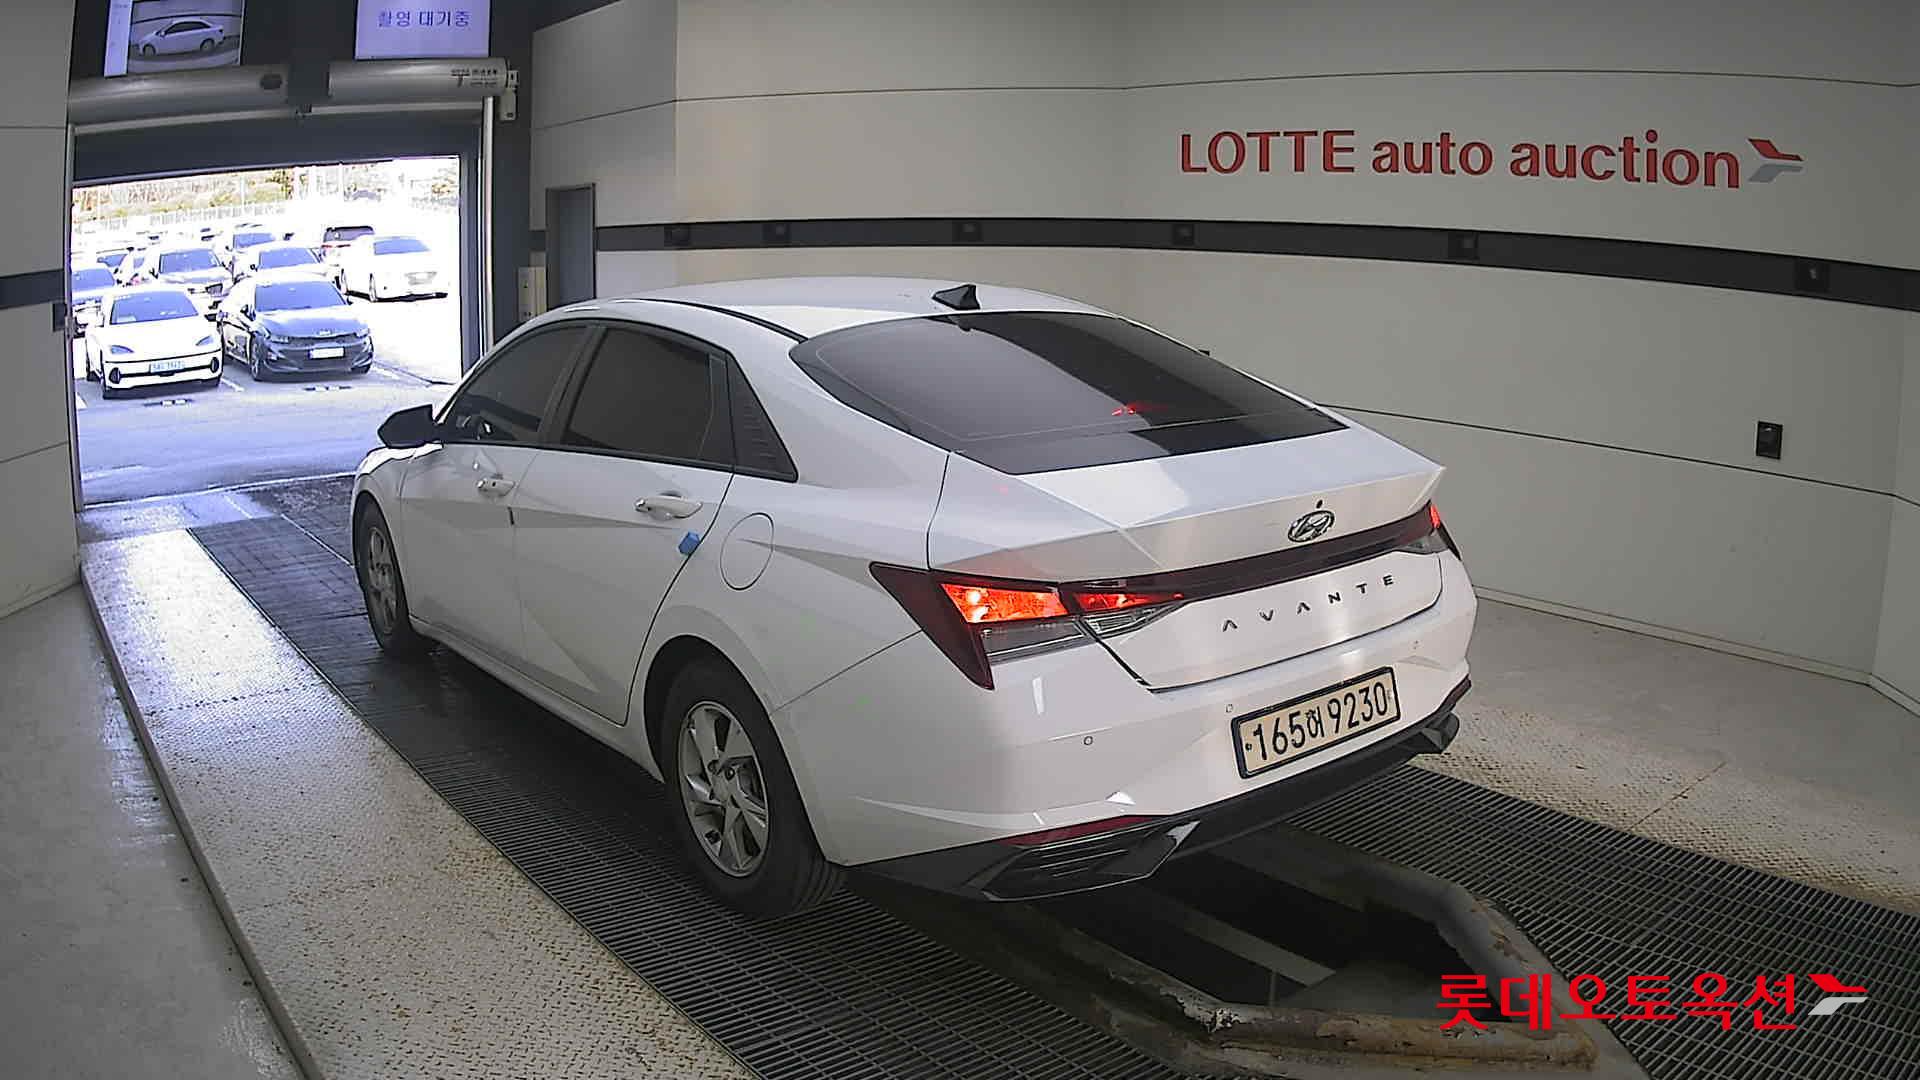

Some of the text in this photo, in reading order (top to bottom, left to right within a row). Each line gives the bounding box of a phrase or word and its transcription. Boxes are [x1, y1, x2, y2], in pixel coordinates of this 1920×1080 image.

[415, 11, 469, 27] 대기중
[1179, 129, 1740, 189] LOTTE auto auction
[1221, 574, 1394, 632] AVANTE
[1327, 682, 1388, 733] 9230
